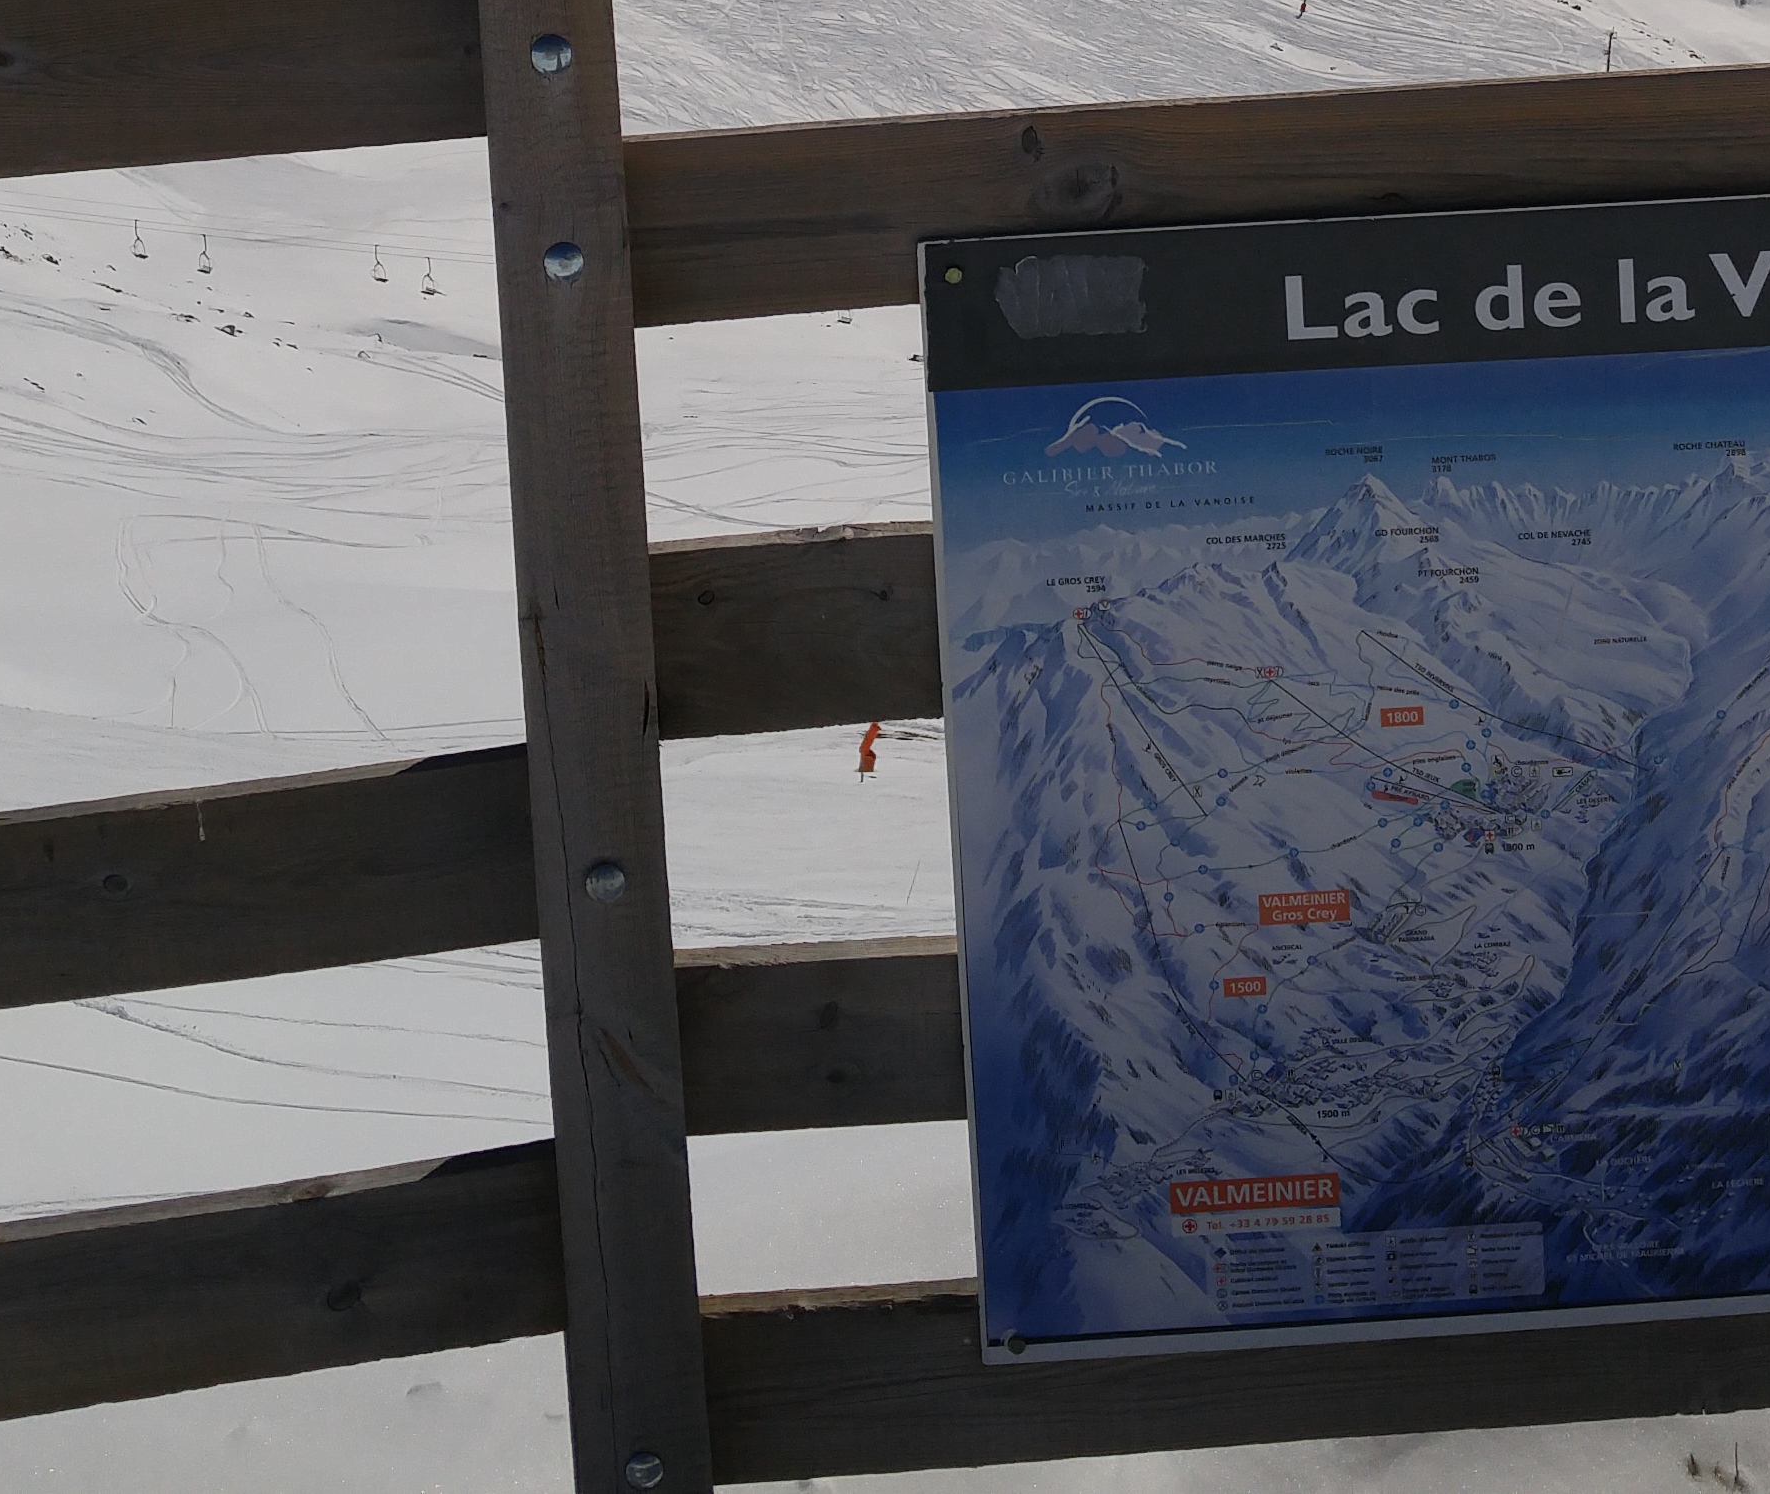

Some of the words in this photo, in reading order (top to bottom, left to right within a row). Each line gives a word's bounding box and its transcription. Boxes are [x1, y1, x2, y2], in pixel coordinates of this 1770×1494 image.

[1285, 275, 1440, 341] Lac
[1475, 264, 1581, 332] de
[1618, 258, 1696, 324] la
[1673, 442, 1703, 451] ROCHE
[1705, 440, 1746, 449] CHATEAU
[1325, 448, 1354, 457] ROCHE
[1357, 446, 1383, 455] NOIRE
[1432, 456, 1457, 465] MONT
[1460, 454, 1497, 463] THABOR
[1003, 464, 1114, 485] GALIBIER
[1124, 460, 1218, 478] THABOR
[1086, 502, 1137, 513] MASSIF
[1146, 501, 1162, 509] DE
[1170, 499, 1186, 508] LA
[1195, 496, 1256, 506] VANOISE
[1375, 529, 1388, 538] GD
[1390, 527, 1439, 537] FOURCHON
[1518, 533, 1535, 541] COL
[1537, 532, 1549, 540] DE
[1551, 529, 1592, 539] NEVACHE
[1206, 536, 1223, 545] COL
[1225, 536, 1242, 544] DES
[1244, 533, 1286, 544] MARCHES
[1571, 538, 1592, 546] 2745
[1267, 542, 1286, 550] 2725
[1418, 570, 1428, 578] PT
[1431, 567, 1479, 577] FOURCHON
[1046, 579, 1056, 587] LE
[1058, 578, 1082, 586] GROS
[1084, 576, 1106, 585] CREY
[1460, 576, 1480, 584] 2459
[1386, 710, 1419, 724] 1800
[1262, 892, 1346, 908] VALMEINIER
[1272, 909, 1304, 922] Gros
[1307, 907, 1338, 922] Crey
[1230, 980, 1262, 994] 1500
[1317, 1109, 1339, 1119] 1500
[1341, 1109, 1351, 1117] m
[1712, 1181, 1724, 1189] LA
[1176, 1178, 1334, 1206] VALMEINIER
[1206, 1220, 1225, 1230] Tel.
[1229, 1220, 1250, 1229] +33
[1254, 1219, 1261, 1227] 4
[1265, 1218, 1278, 1227] 79
[1282, 1217, 1296, 1225] 59
[1300, 1216, 1313, 1224] 28
[1317, 1214, 1330, 1223] 85
